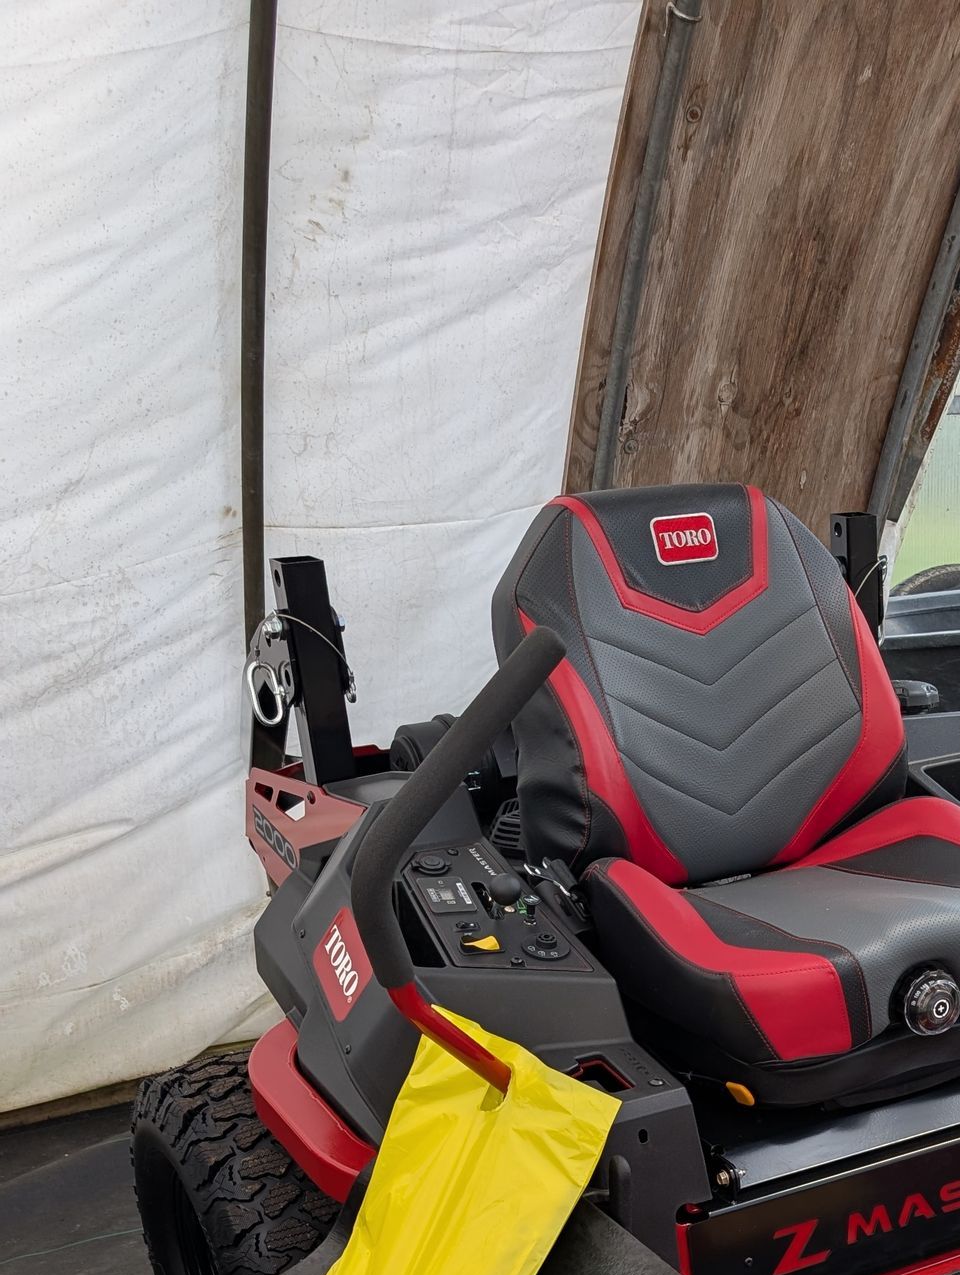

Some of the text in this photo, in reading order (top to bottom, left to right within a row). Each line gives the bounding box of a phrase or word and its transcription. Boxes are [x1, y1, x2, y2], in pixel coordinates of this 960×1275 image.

[659, 528, 712, 549] TORO
[253, 806, 296, 869] 2000
[468, 847, 497, 876] MASTER
[324, 924, 359, 997] TORO
